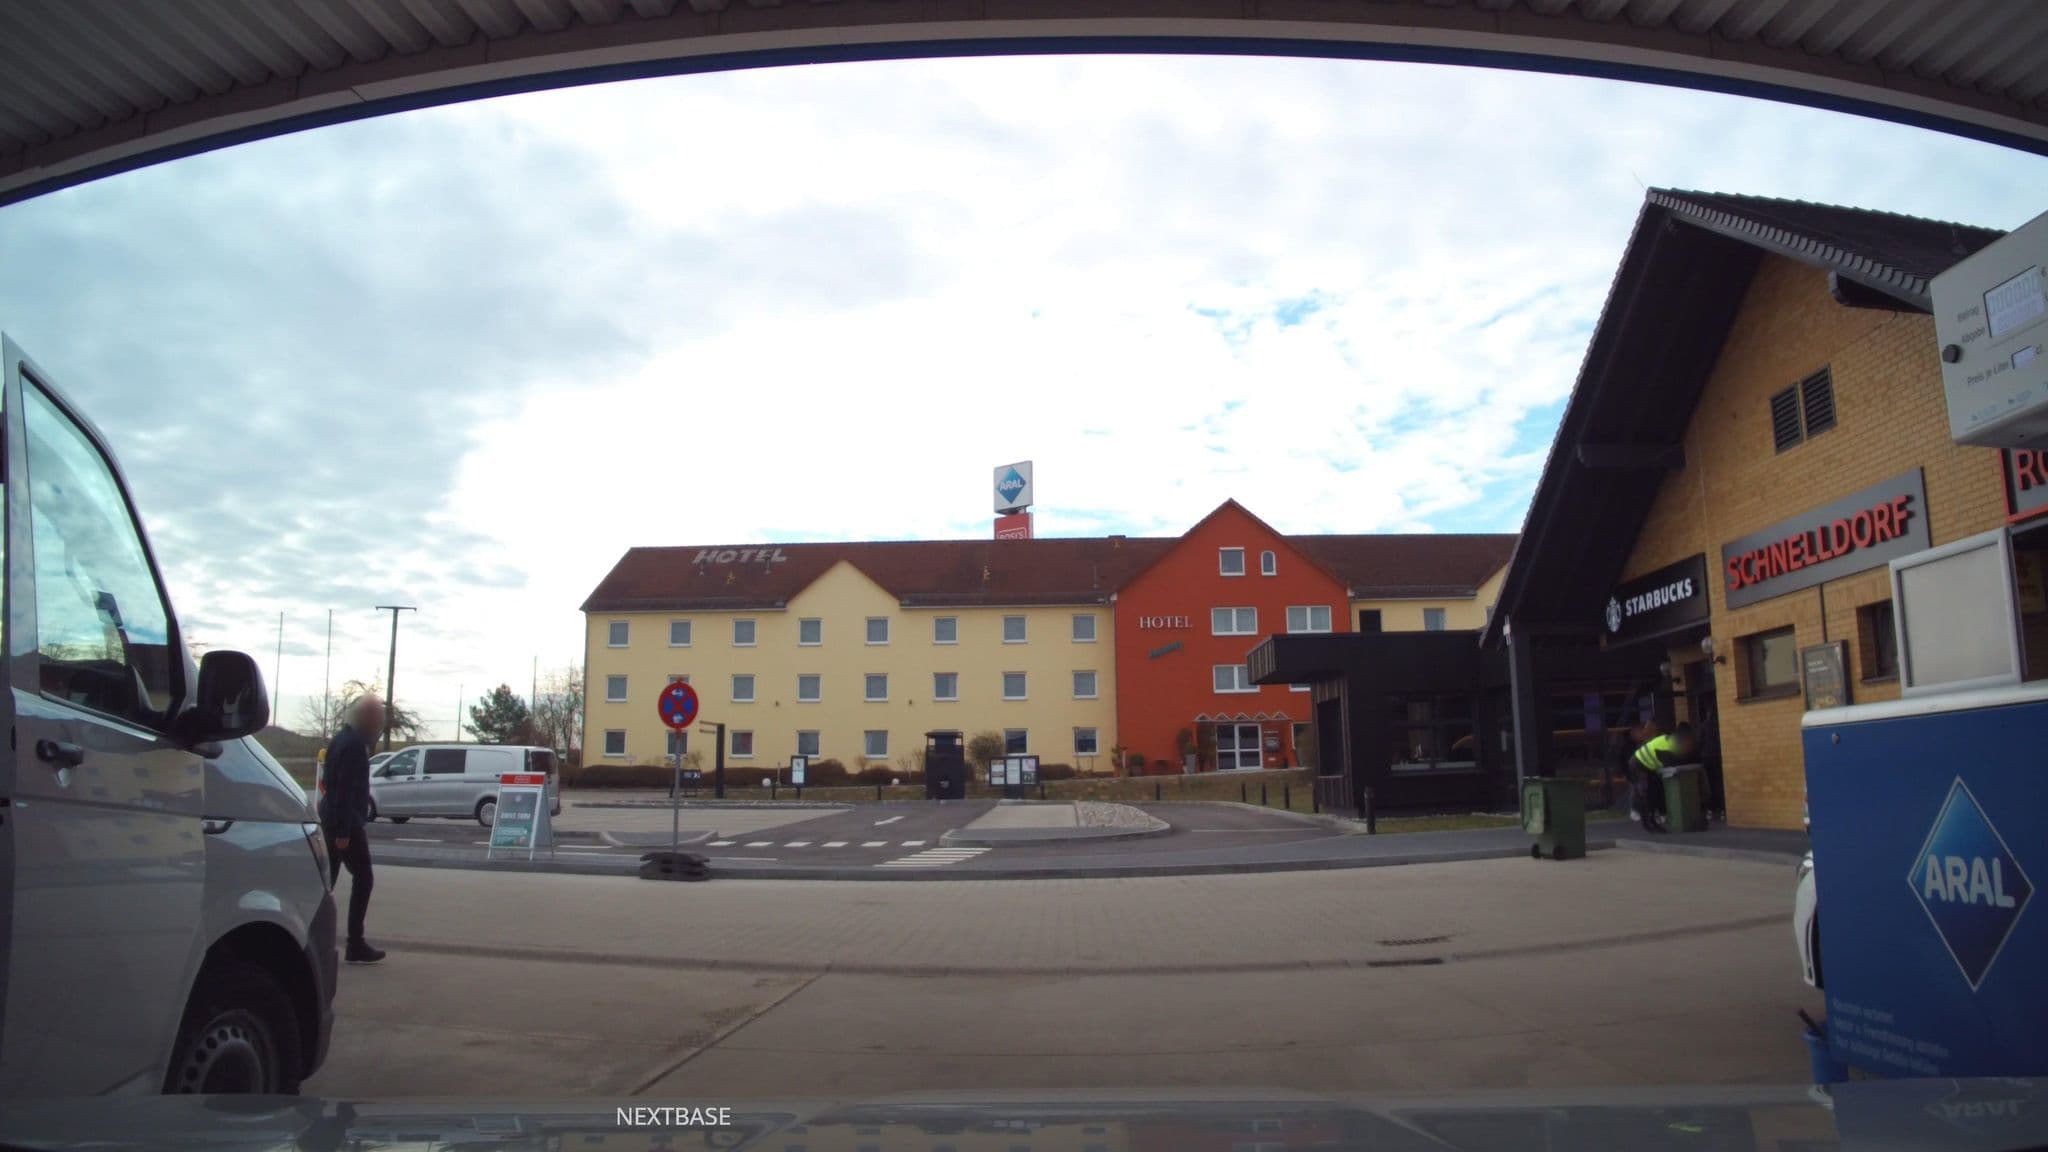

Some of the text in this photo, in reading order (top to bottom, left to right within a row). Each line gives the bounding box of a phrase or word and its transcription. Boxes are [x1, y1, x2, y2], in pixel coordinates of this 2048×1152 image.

[1000, 479, 1023, 491] ARAL
[693, 548, 787, 564] HOTEL
[1727, 495, 1911, 591] SCHNELLDORF
[1625, 577, 1693, 617] STARBUCKS
[1139, 616, 1193, 630] HOTEL
[1924, 854, 2016, 908] ARAL
